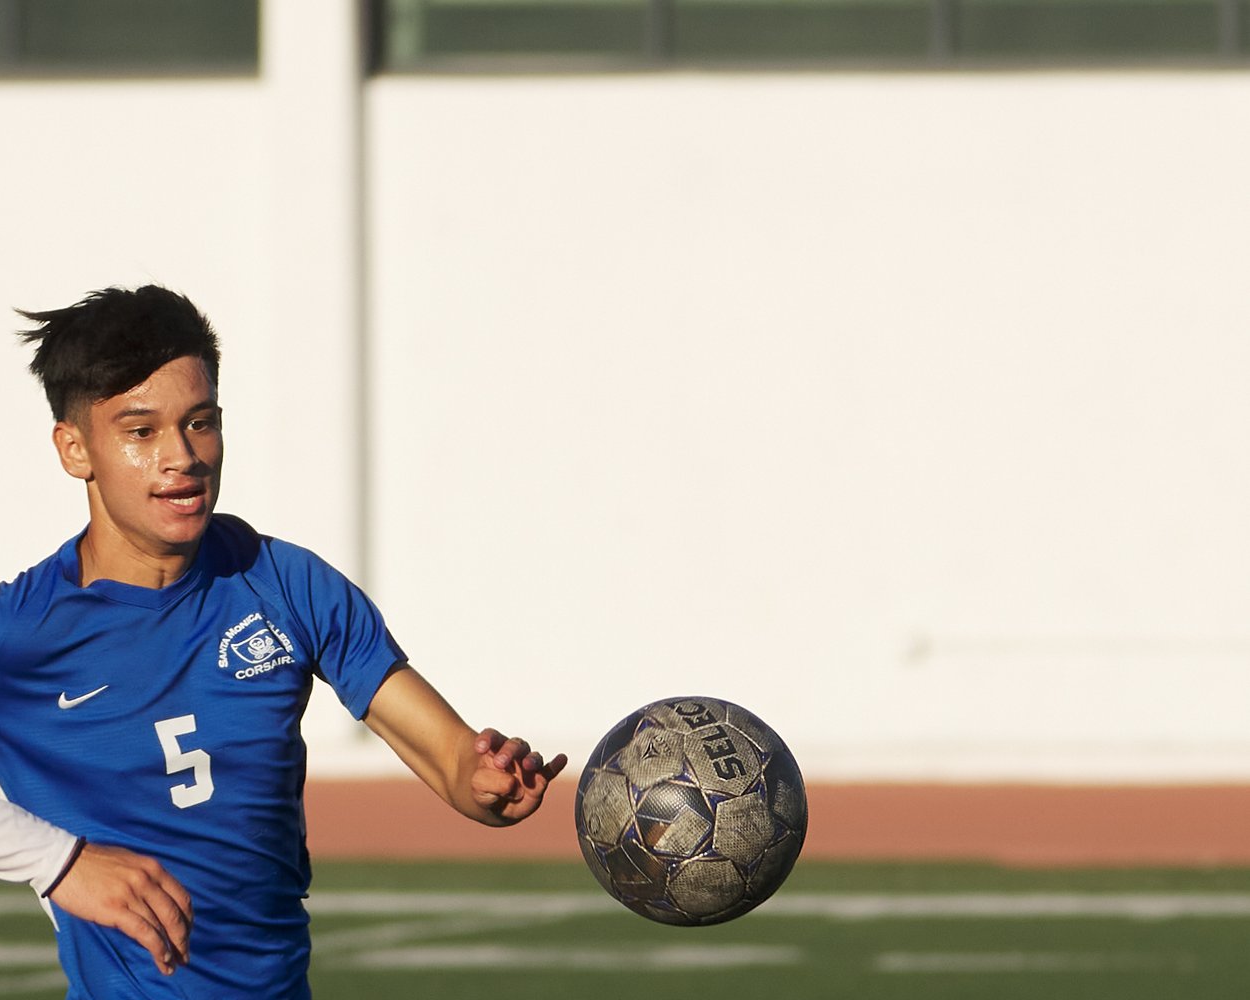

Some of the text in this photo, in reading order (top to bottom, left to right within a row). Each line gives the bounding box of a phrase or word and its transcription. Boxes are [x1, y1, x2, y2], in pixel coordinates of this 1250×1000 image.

[218, 638, 230, 668] SANTA
[225, 612, 262, 639] MONICA
[154, 714, 214, 809] 5
[664, 700, 747, 780] SELEC
